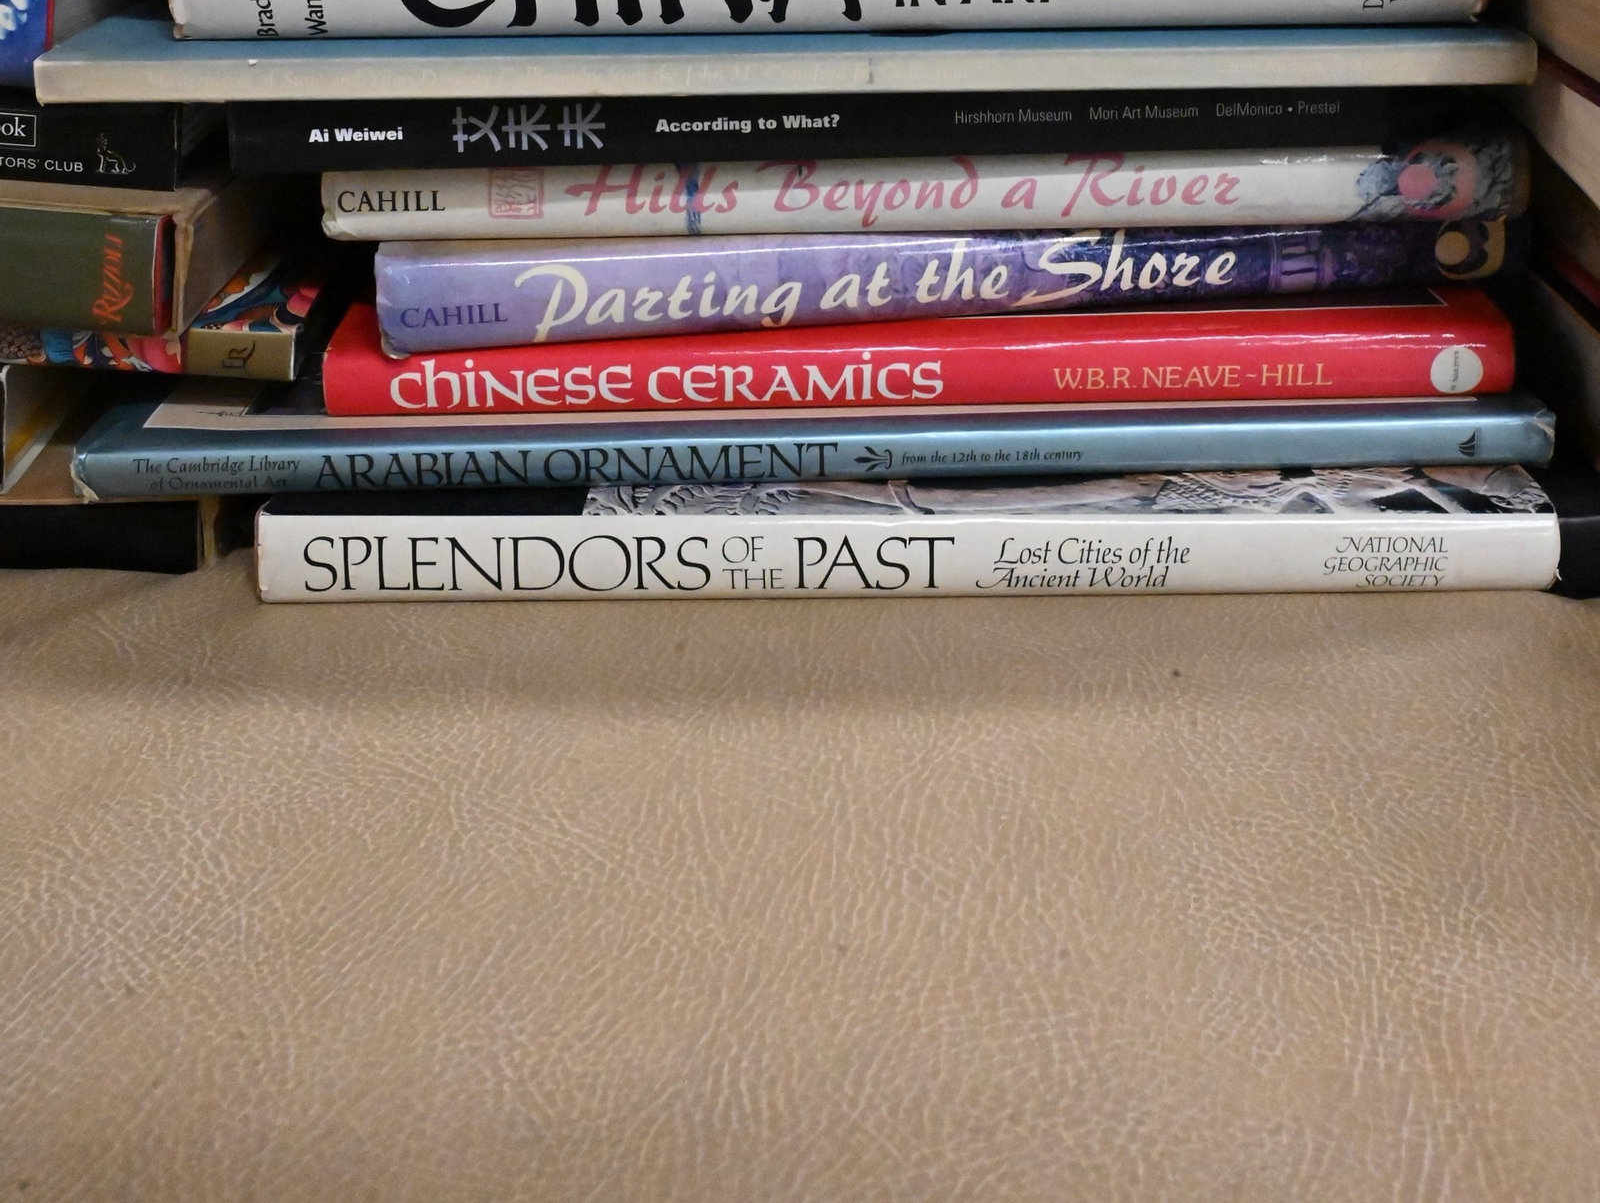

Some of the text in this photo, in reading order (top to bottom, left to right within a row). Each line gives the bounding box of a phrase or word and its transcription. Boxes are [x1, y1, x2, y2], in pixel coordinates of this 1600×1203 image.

[955, 109, 1072, 124] Hirshhorn Museum
[1089, 105, 1199, 121] Mori Art Museum
[1216, 101, 1340, 117] DelMonico Prestel
[0, 116, 26, 137] ok
[309, 126, 403, 143] Ai Weiwei
[655, 114, 840, 134] According to What?
[44, 160, 84, 173] CLUB
[565, 163, 738, 216] Hills
[757, 156, 978, 228] Beyond
[1001, 177, 1037, 209] a
[1061, 151, 1241, 217] River
[337, 189, 446, 214] CAHILL
[514, 227, 1237, 343] Parting at the Shore
[400, 302, 508, 329] CAHILL
[132, 454, 301, 475] The Cambridge Library
[313, 443, 839, 489] ARABIAN ORNAMENT
[900, 448, 1084, 465] from the 12th to the 18th century
[150, 475, 288, 491] of Ornamental Art
[721, 535, 764, 563] OF
[994, 536, 1190, 570] Lost Cities of the
[1336, 536, 1448, 554] NATIONAL
[303, 535, 712, 592] SPLENDORS
[793, 535, 955, 591] PAST
[1323, 556, 1448, 576] GEOGRAPHIC
[722, 568, 785, 591] THE
[975, 565, 1169, 589] Ancient World
[1356, 574, 1445, 588] SOCIETY
